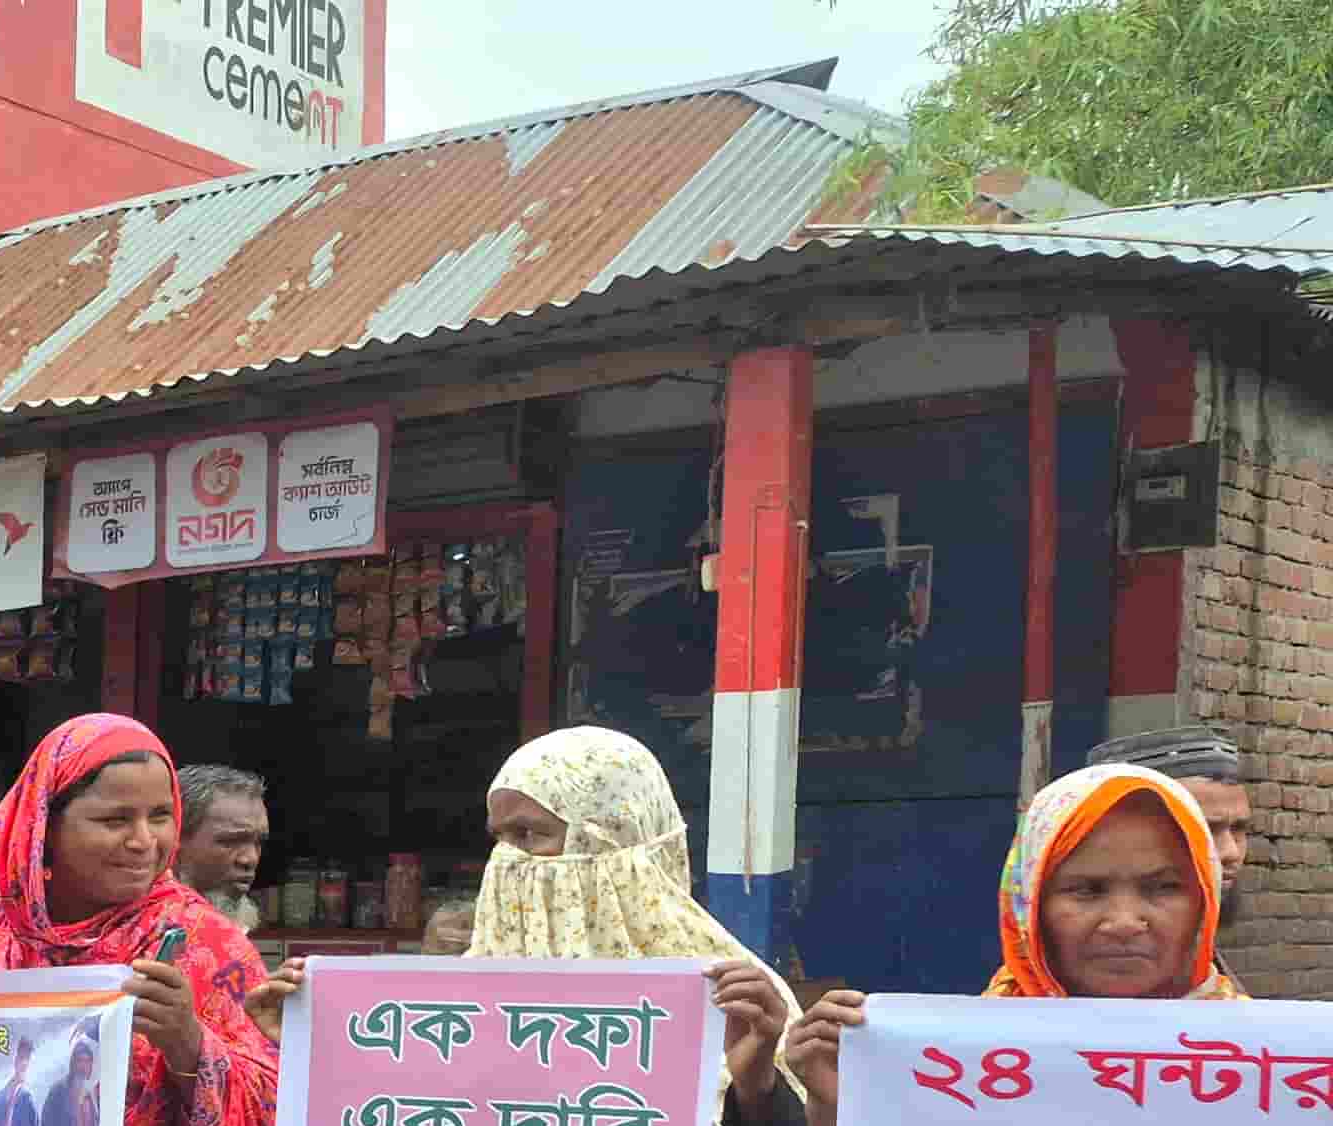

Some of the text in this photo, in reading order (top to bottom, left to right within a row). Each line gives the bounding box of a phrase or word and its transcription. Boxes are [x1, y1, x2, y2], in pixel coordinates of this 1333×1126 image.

[113, 490, 147, 514] মানি
[282, 473, 373, 503] ক্যাশ আউট
[177, 508, 256, 546] নগদ
[308, 501, 342, 523] চার্জ
[101, 518, 126, 545] ফ্রি
[347, 996, 669, 1073] এক দফা
[912, 1032, 1333, 1115] ২৪ ঘন্টার
